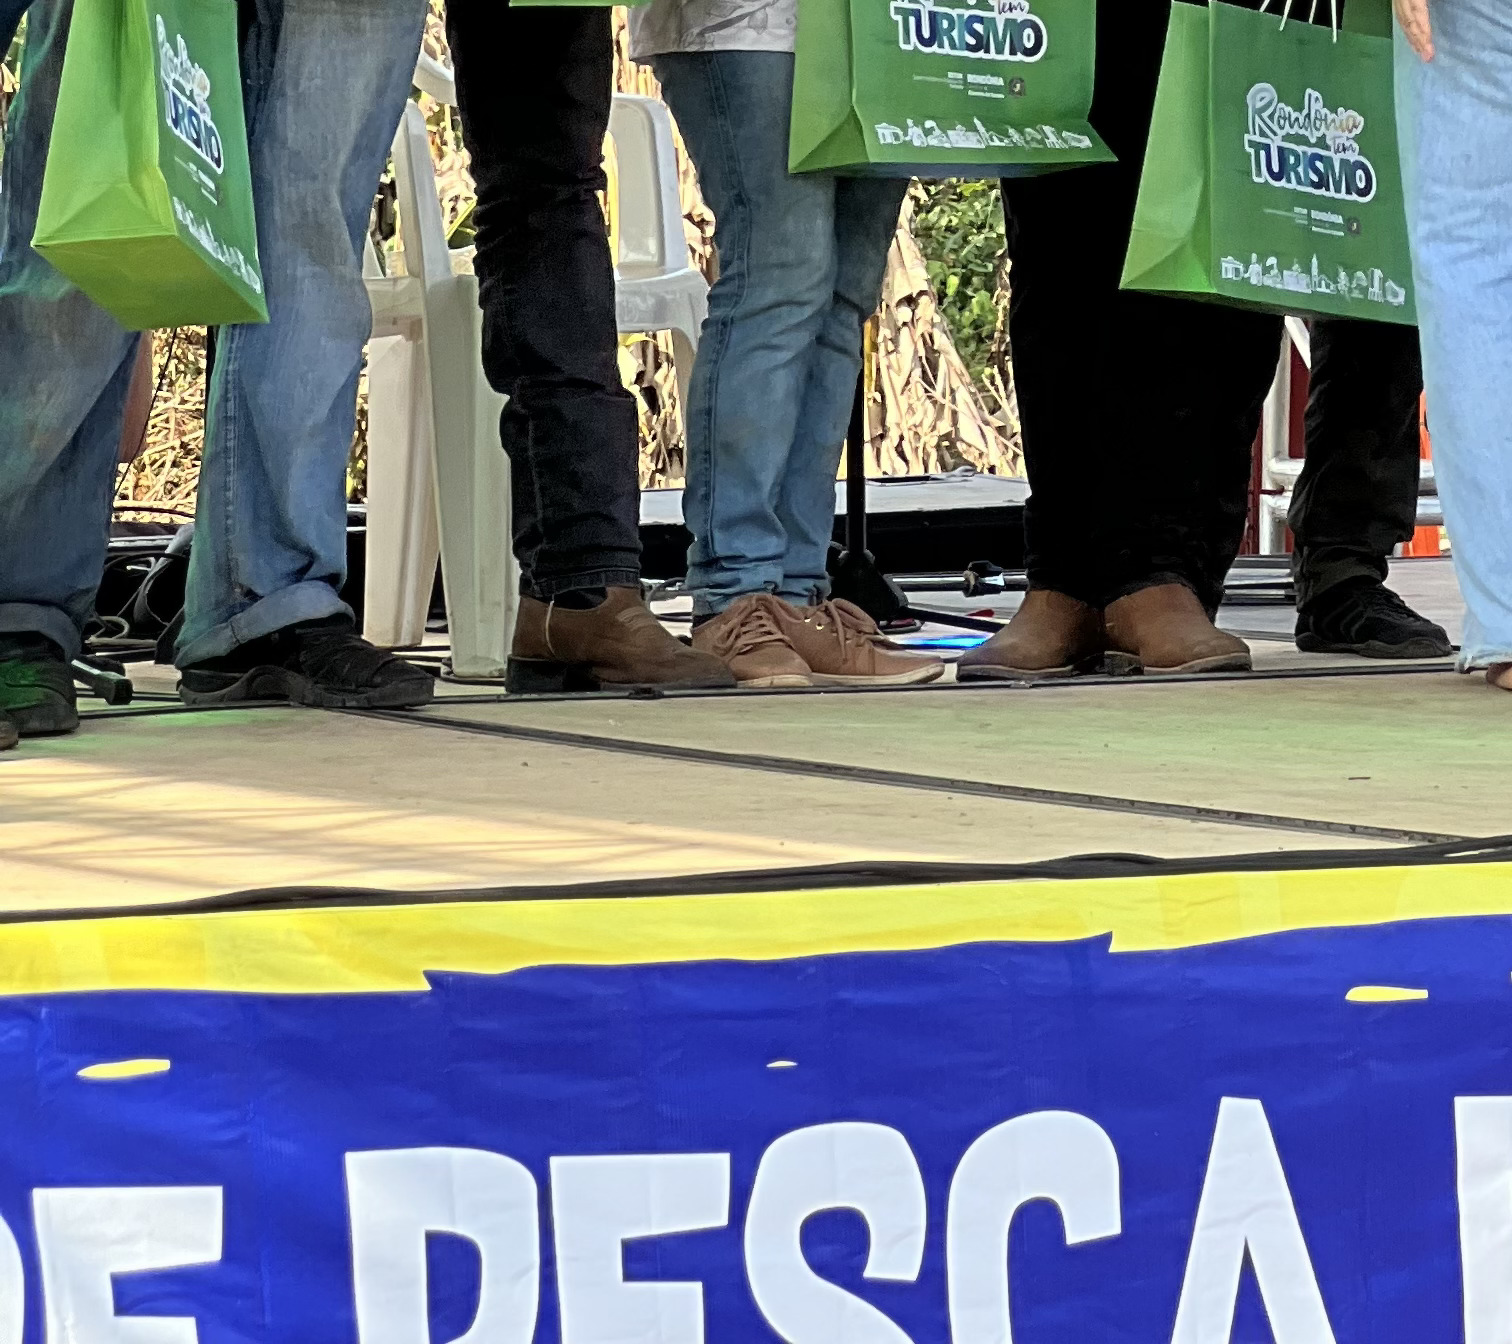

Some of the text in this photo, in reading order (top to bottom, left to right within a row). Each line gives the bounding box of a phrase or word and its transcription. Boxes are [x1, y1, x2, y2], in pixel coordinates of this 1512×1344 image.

[890, 3, 1047, 62] TURISMO
[1244, 135, 1376, 203] TURISMO
[345, 1096, 1338, 1344] PESCA
